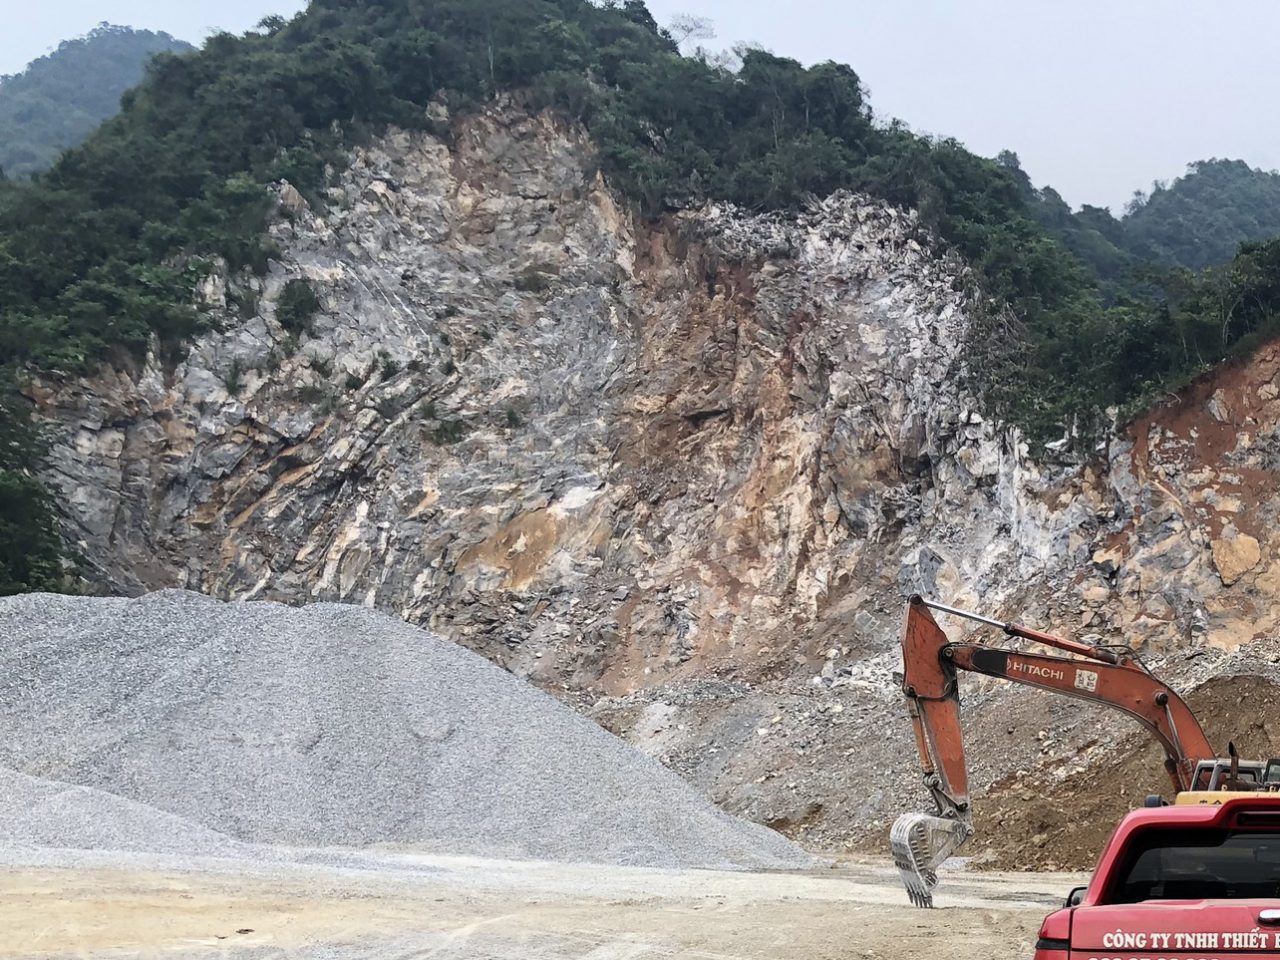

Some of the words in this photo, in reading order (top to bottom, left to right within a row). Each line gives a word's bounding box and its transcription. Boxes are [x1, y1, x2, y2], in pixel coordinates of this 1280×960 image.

[1013, 661, 1064, 680] HITACHI
[1102, 929, 1147, 949] CÔNG
[1150, 933, 1171, 949] TY
[1174, 933, 1218, 949] TNHH
[1221, 926, 1269, 949] THIẾT
